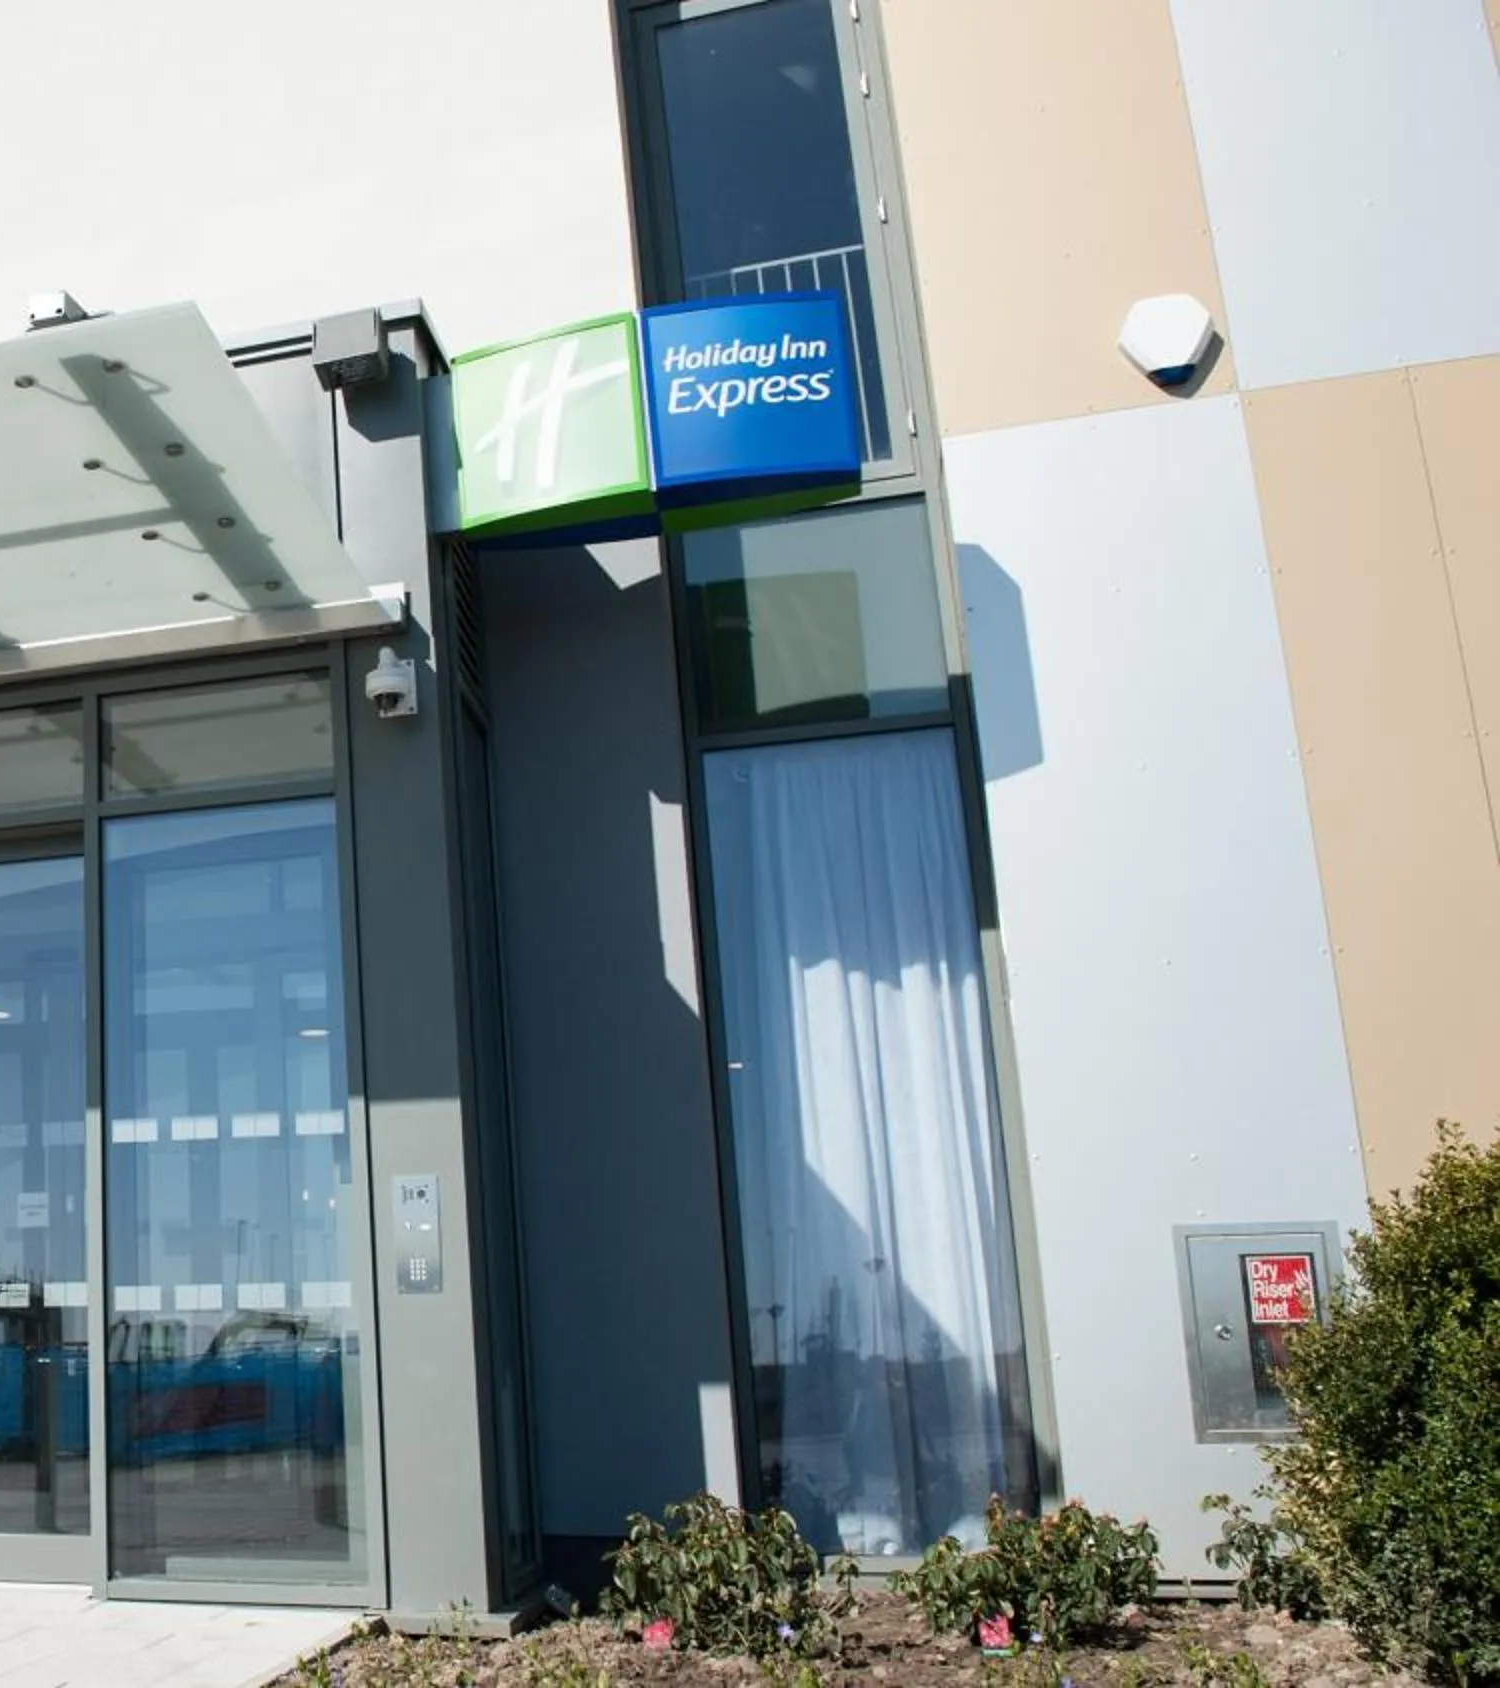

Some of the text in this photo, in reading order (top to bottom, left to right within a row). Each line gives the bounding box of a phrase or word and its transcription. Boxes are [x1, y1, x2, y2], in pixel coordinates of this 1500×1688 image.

[663, 333, 827, 372] Holiday Inn
[667, 370, 832, 418] Express
[1252, 1261, 1278, 1282] Dry
[1253, 1280, 1295, 1298] Riser
[1253, 1299, 1290, 1318] Inlet
